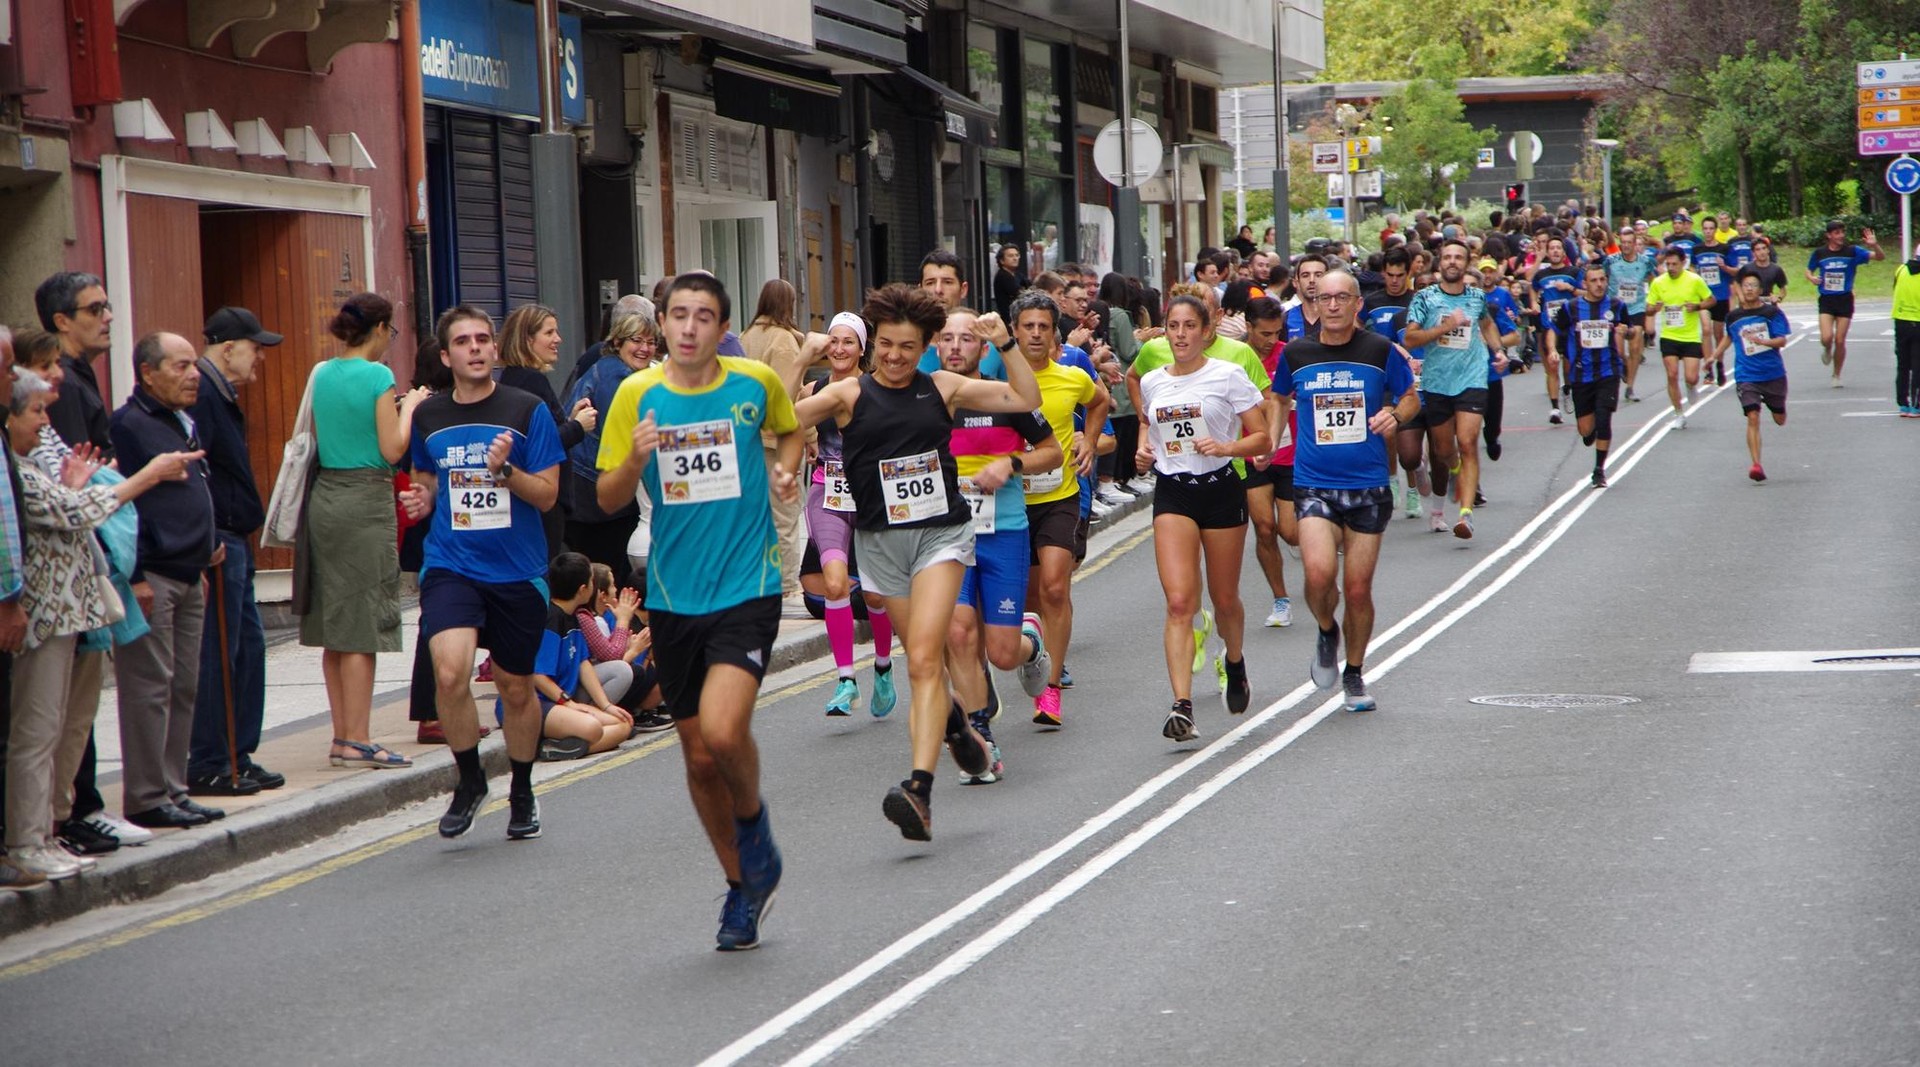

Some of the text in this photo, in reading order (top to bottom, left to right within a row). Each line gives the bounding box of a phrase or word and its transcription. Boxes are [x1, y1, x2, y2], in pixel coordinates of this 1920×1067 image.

[1587, 330, 1604, 338] 755
[964, 416, 993, 428] 226ERS
[1326, 411, 1356, 427] 187
[1173, 421, 1194, 438] 26
[674, 451, 722, 476] 346
[896, 477, 934, 500] 508
[461, 492, 498, 508] 426
[966, 498, 983, 513] 7
